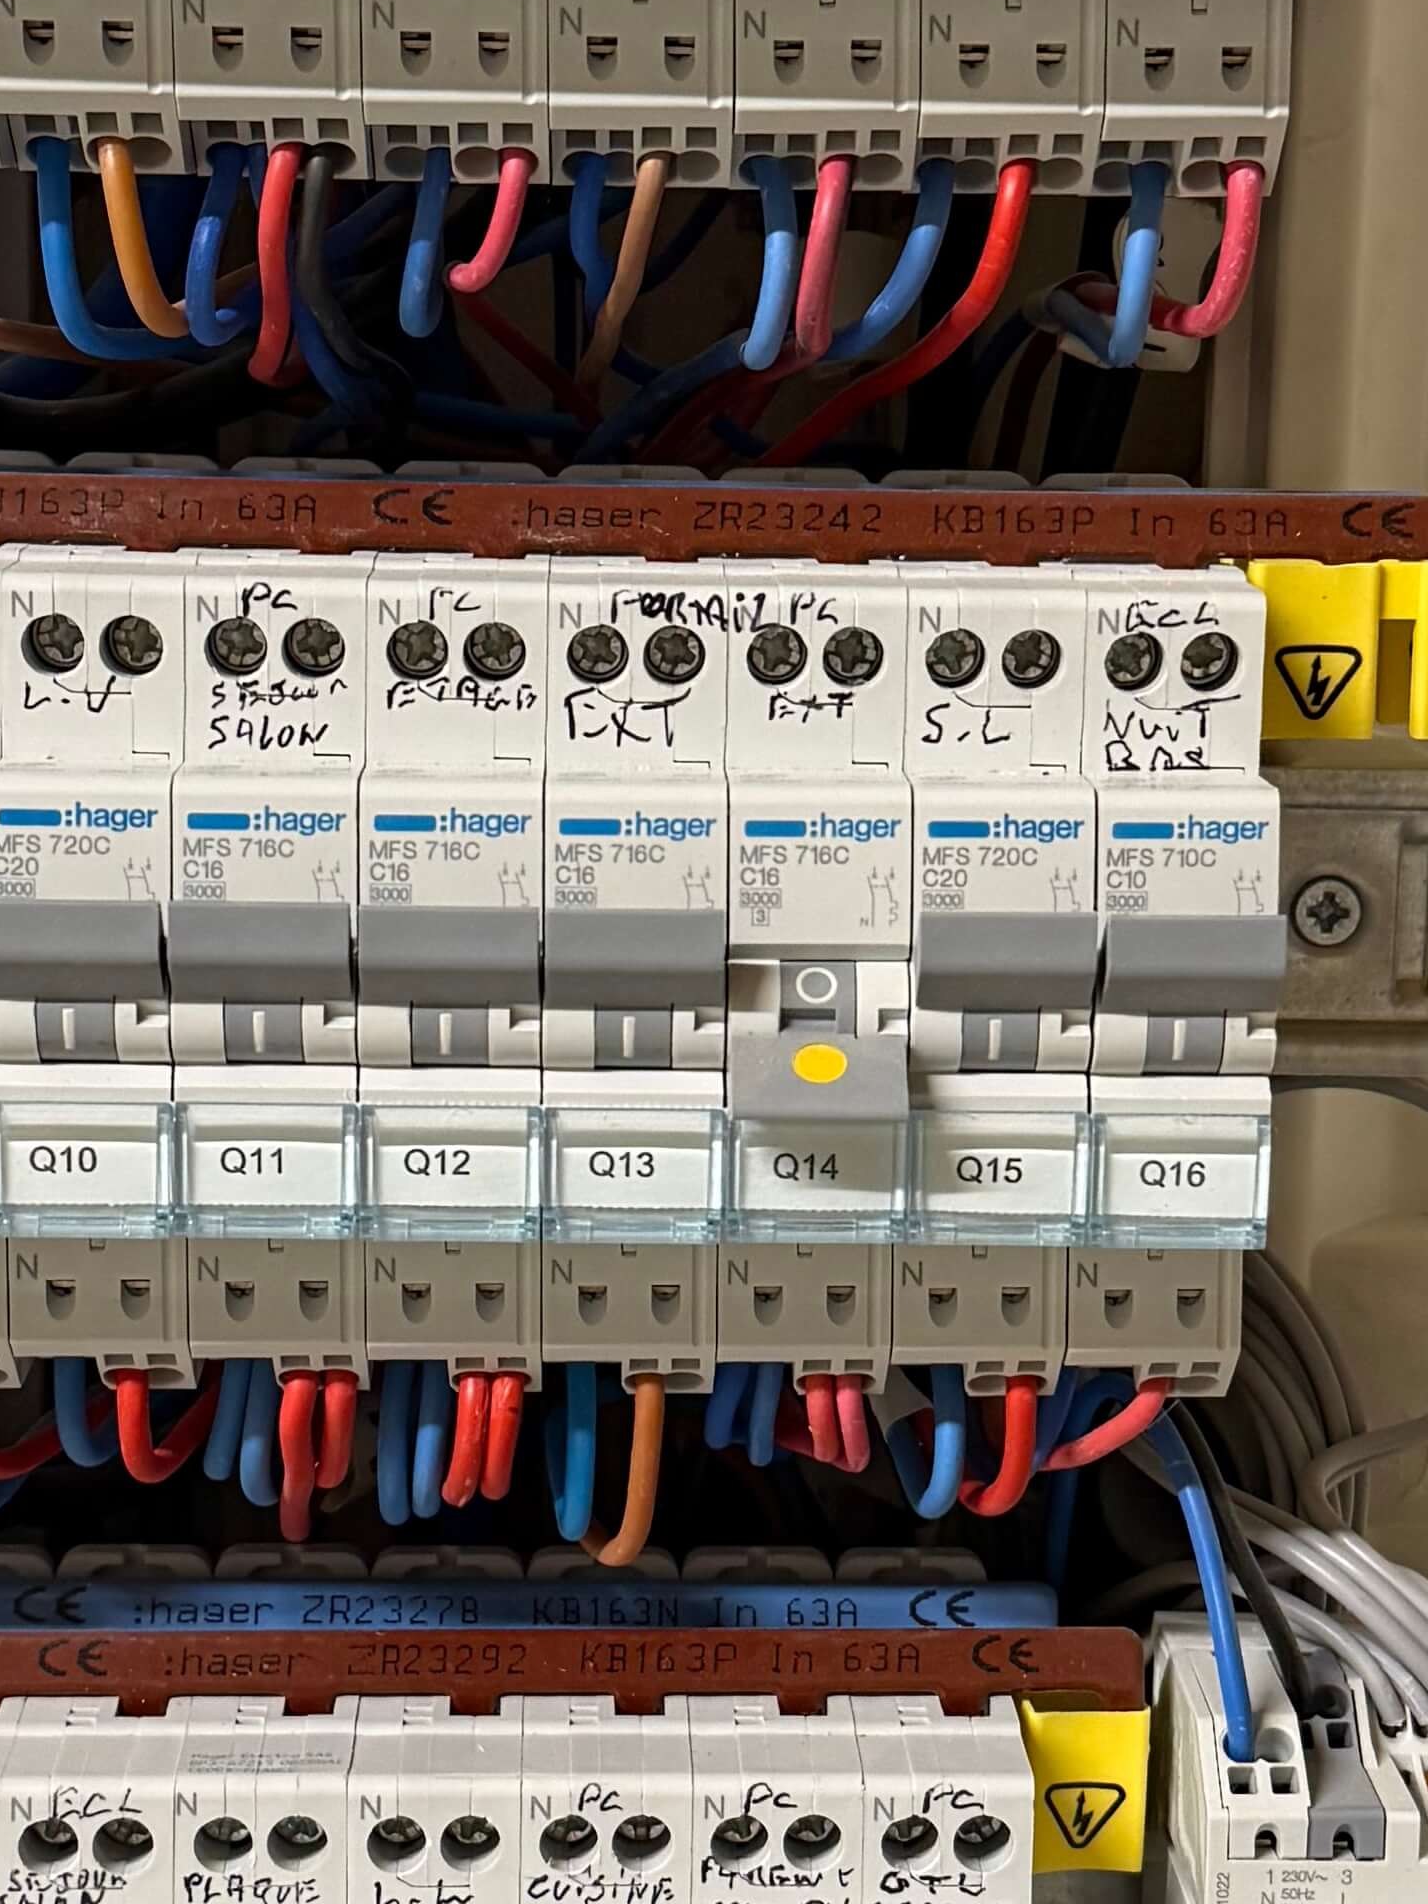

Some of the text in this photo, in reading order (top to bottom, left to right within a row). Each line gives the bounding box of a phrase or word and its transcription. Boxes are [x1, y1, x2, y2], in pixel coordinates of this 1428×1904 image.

[693, 503, 884, 533] ZR23242
[933, 505, 1095, 535] KB163P
[1106, 849, 1217, 868] MFS 710C
[1106, 870, 1146, 889] C10
[29, 1147, 97, 1175] Q10
[219, 1148, 284, 1175] Q11
[404, 1149, 471, 1177] Q12
[588, 1151, 655, 1181] Q13
[772, 1153, 839, 1182] Q14
[956, 1157, 1024, 1185] Q15
[1139, 1161, 1206, 1188] Q16
[347, 1644, 528, 1676] ZR23292
[579, 1644, 739, 1674] KB163P
[1266, 1870, 1273, 1884] 1
[1340, 1870, 1353, 1885] 3
[1281, 1888, 1316, 1902] 50Hz
